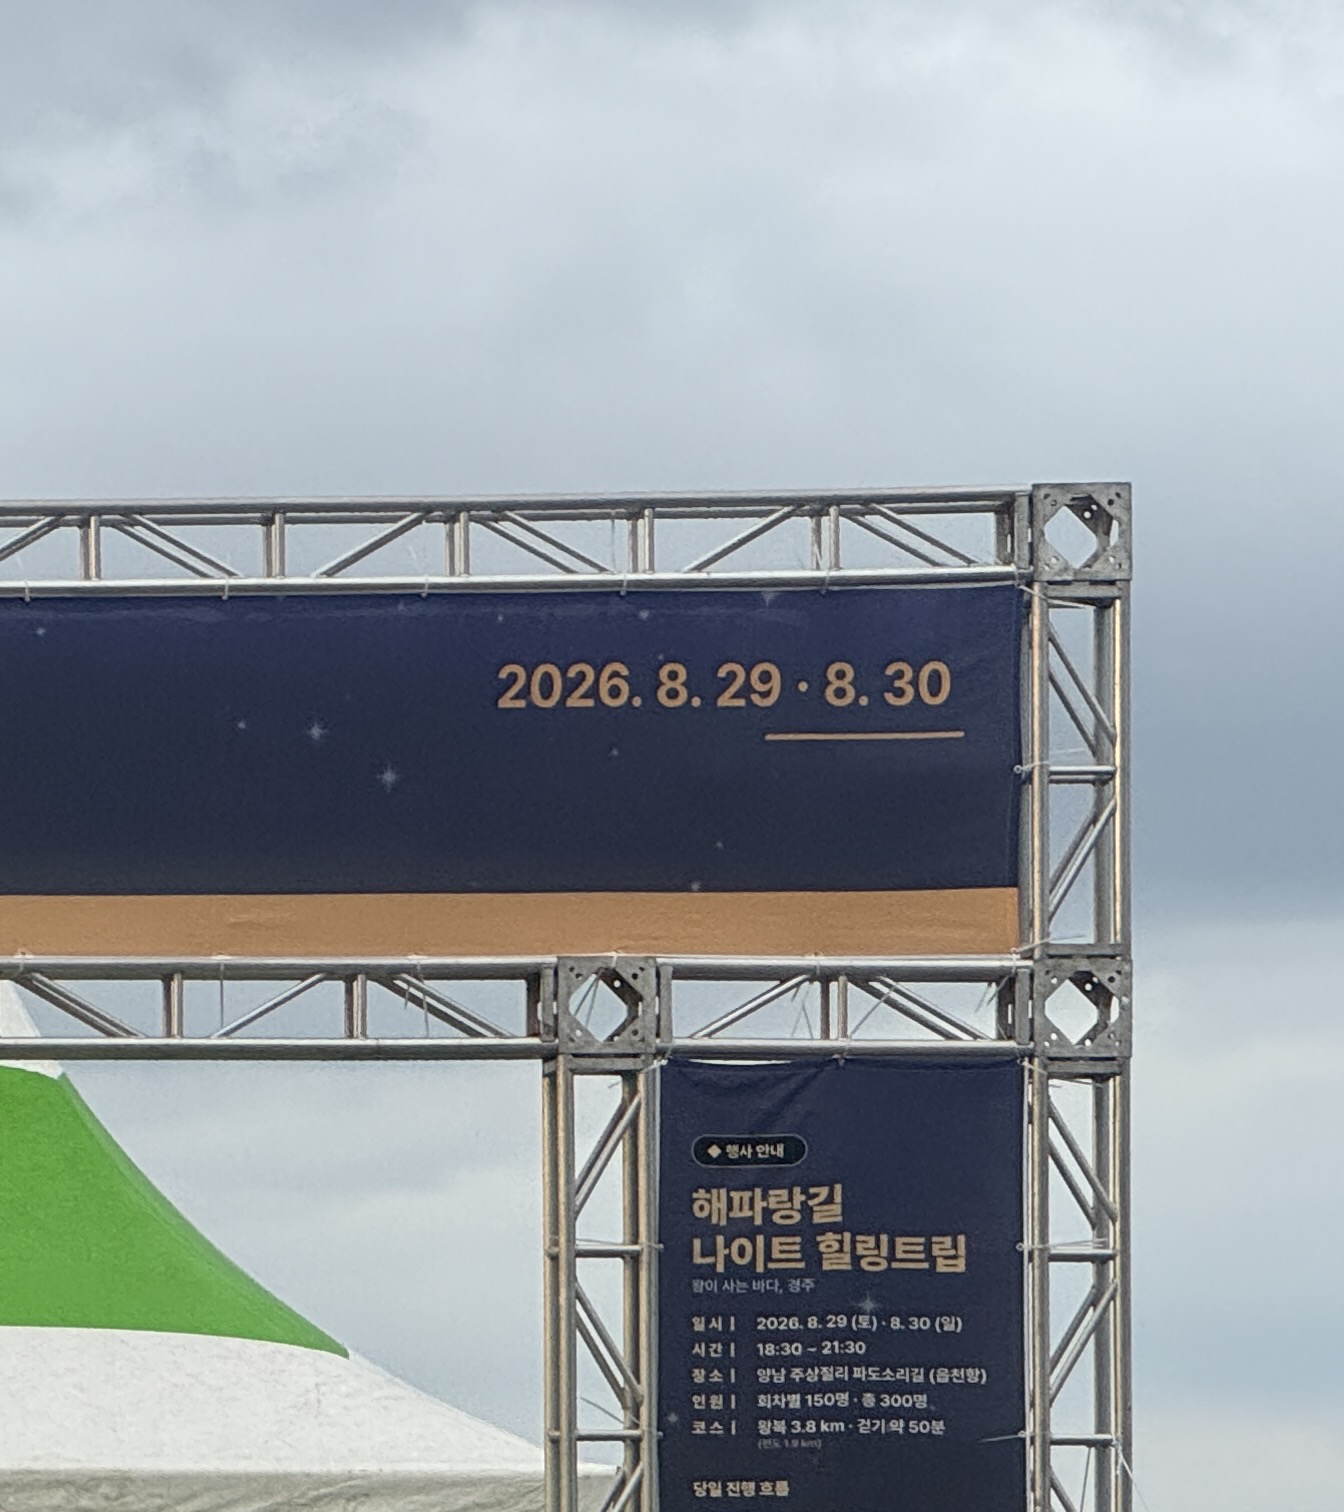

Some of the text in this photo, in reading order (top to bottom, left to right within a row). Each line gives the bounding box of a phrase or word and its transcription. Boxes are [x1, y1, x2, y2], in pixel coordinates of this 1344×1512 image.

[756, 1144, 784, 1159] 안내
[692, 1183, 844, 1227] 해파랑길
[692, 1232, 967, 1274] 나이트 힐링트립
[757, 1317, 804, 1331] 2026.
[826, 1315, 847, 1329] 29
[908, 1317, 931, 1331] 30
[757, 1342, 802, 1357] 18:30
[821, 1340, 866, 1355] 21:30
[853, 1366, 925, 1383] 파도소리길
[879, 1392, 928, 1408] 300명
[790, 1420, 817, 1434] 3.8
[820, 1418, 845, 1433] km
[908, 1418, 946, 1434] 50분
[726, 1480, 756, 1498] 진행
